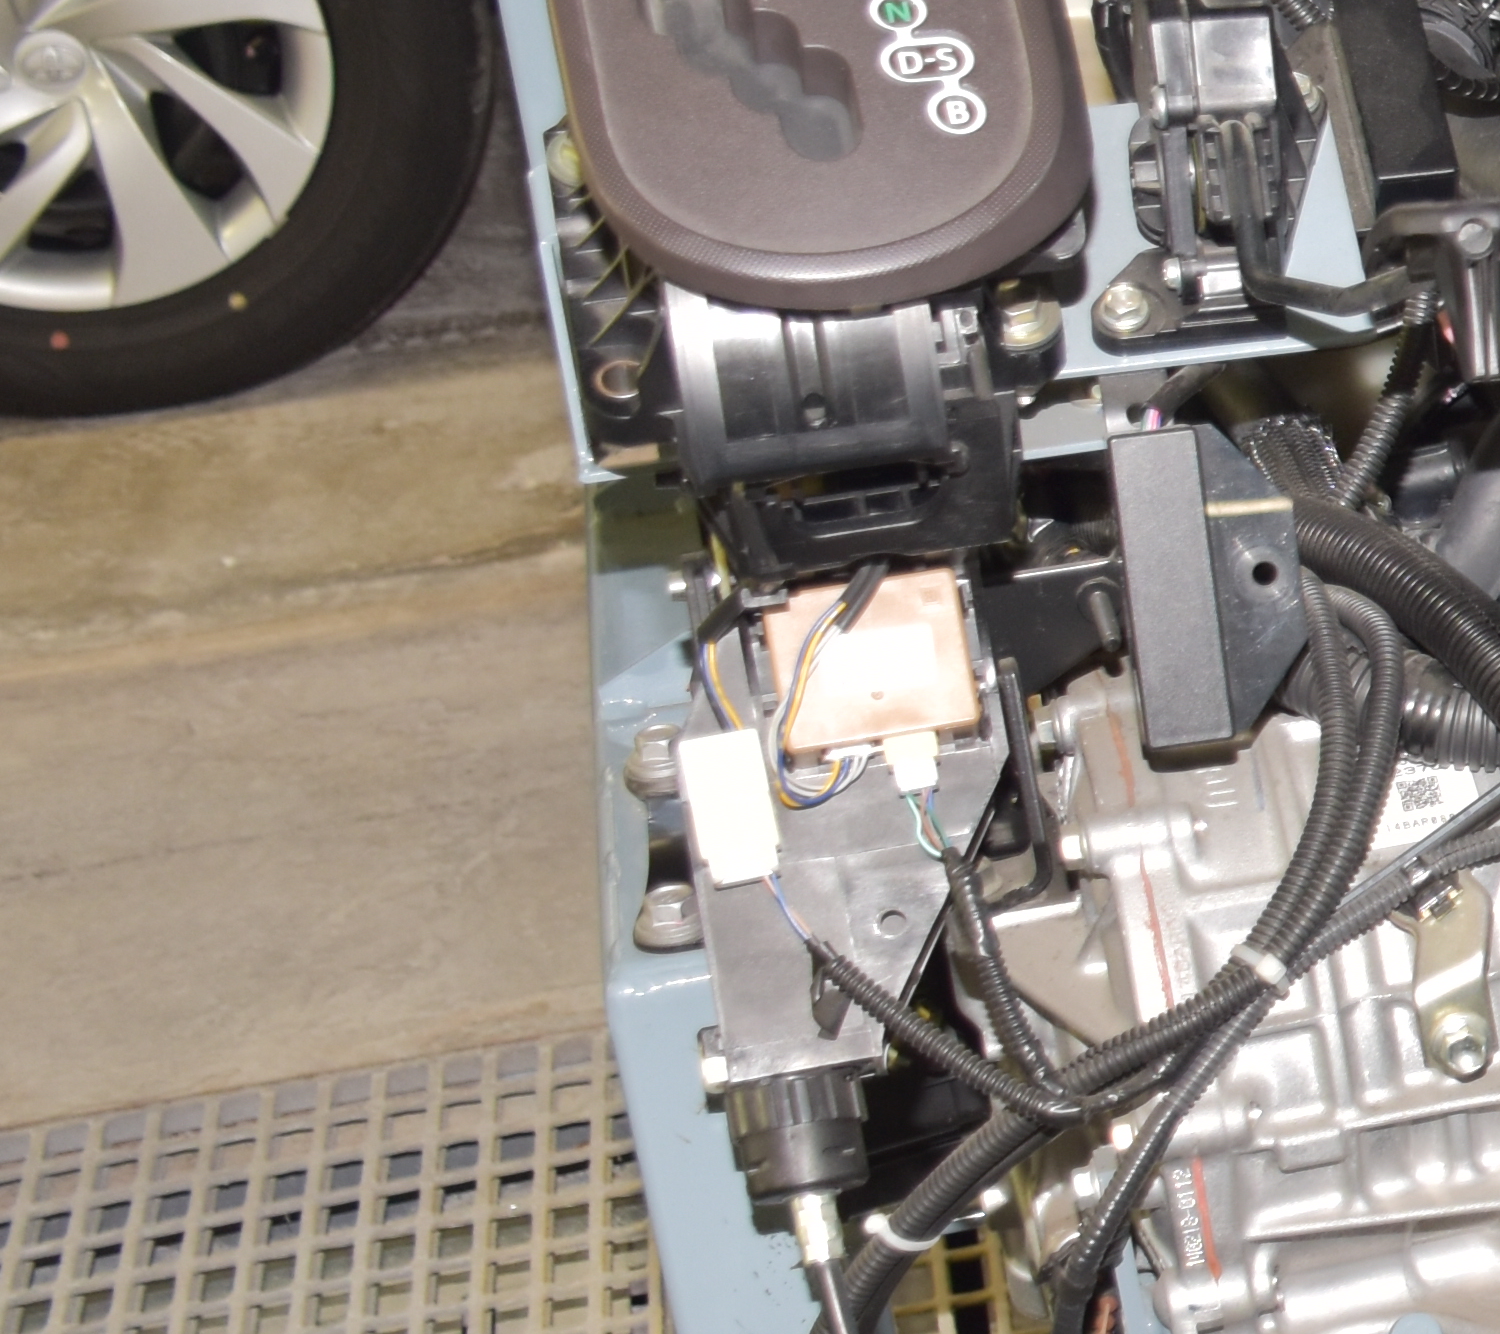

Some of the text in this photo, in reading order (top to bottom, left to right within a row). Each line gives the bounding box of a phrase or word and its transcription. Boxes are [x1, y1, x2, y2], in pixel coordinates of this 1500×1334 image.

[884, 0, 911, 23] N
[896, 47, 956, 75] D-S
[946, 101, 969, 125] B
